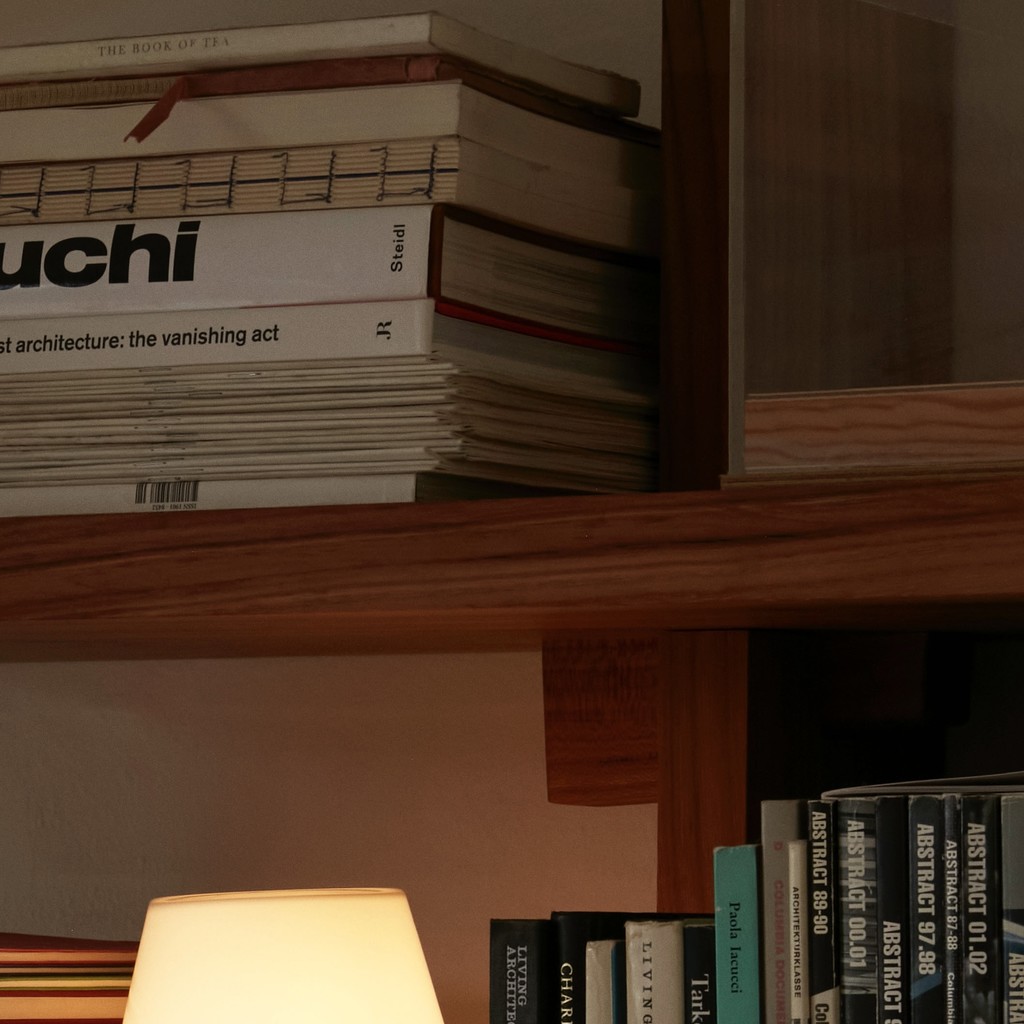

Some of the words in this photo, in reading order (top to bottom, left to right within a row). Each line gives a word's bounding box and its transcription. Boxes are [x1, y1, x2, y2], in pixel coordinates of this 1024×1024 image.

[98, 44, 127, 57] THE
[133, 41, 172, 53] BOOK
[178, 39, 198, 50] OF
[202, 37, 230, 49] TEA
[390, 224, 406, 272] Steidl
[15, 333, 125, 354] architecture:
[128, 330, 157, 348] the
[162, 326, 247, 348] vanishing
[252, 324, 280, 343] act
[812, 811, 827, 886] ABSTRACT
[847, 820, 866, 911] ABSTRACT
[917, 824, 935, 916] ABSTRACT
[967, 822, 986, 916] ABSTRACT
[946, 840, 958, 912] ABSTRACT
[729, 902, 741, 940] Paola
[774, 880, 785, 954] COLUMBIA
[813, 891, 829, 935] 89-90
[947, 916, 958, 950] 87-88
[730, 944, 743, 994] Iacucci
[792, 887, 802, 998] ARCHITEKTURKLASSE
[849, 917, 867, 968] 00.01
[883, 920, 902, 1012] ABSTRACT
[918, 922, 936, 975] 97.98
[968, 922, 987, 975] 01.02
[517, 945, 528, 1007] LIVING
